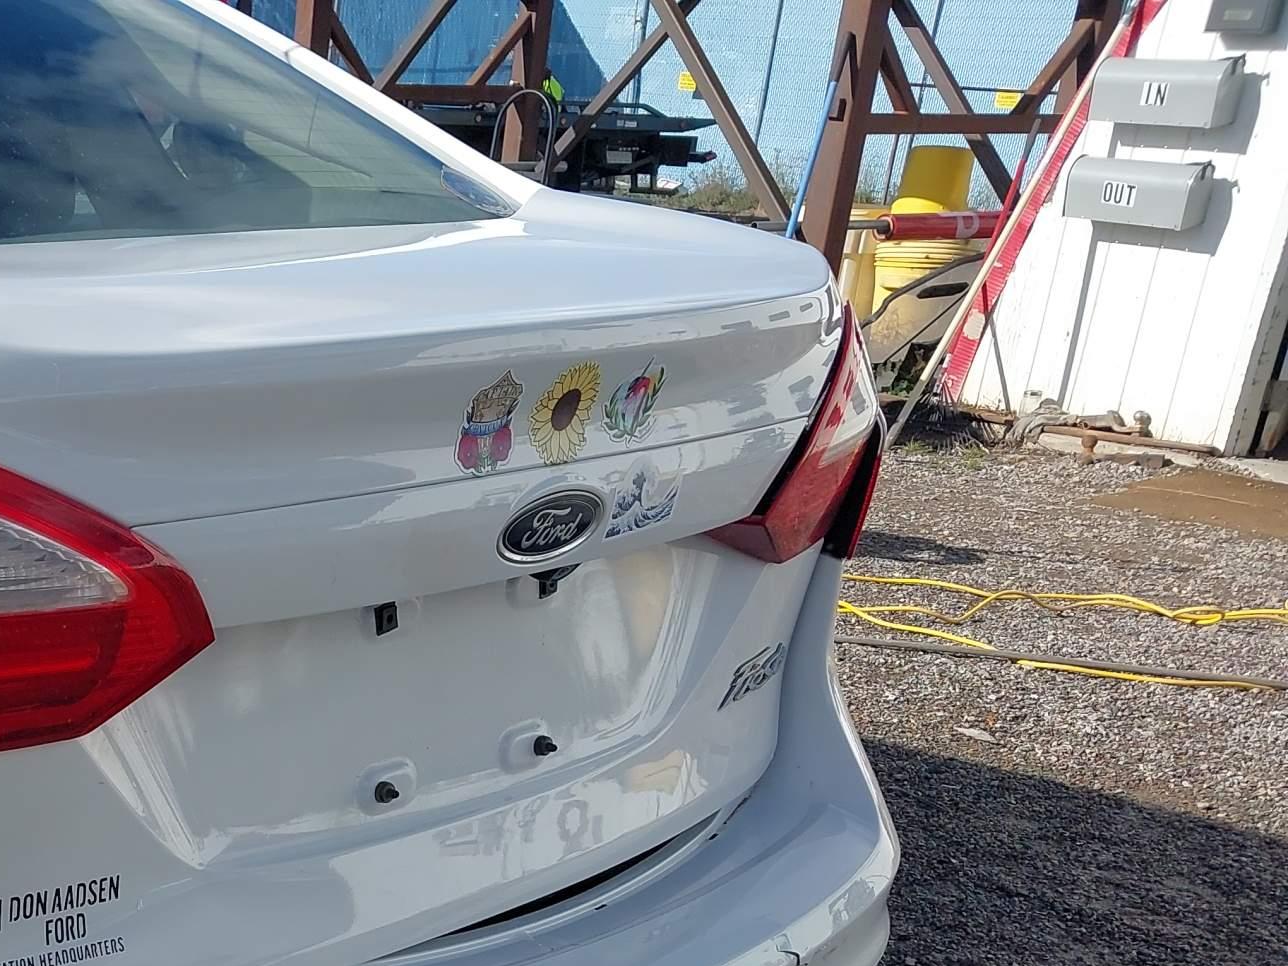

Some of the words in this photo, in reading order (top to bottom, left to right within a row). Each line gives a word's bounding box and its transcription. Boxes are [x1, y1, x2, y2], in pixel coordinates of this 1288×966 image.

[1145, 82, 1169, 107] IN
[1103, 182, 1136, 206] OUT
[520, 506, 583, 549] Ford
[9, 890, 48, 923] DON
[51, 874, 120, 914] AADSEN
[45, 912, 87, 946] FORD
